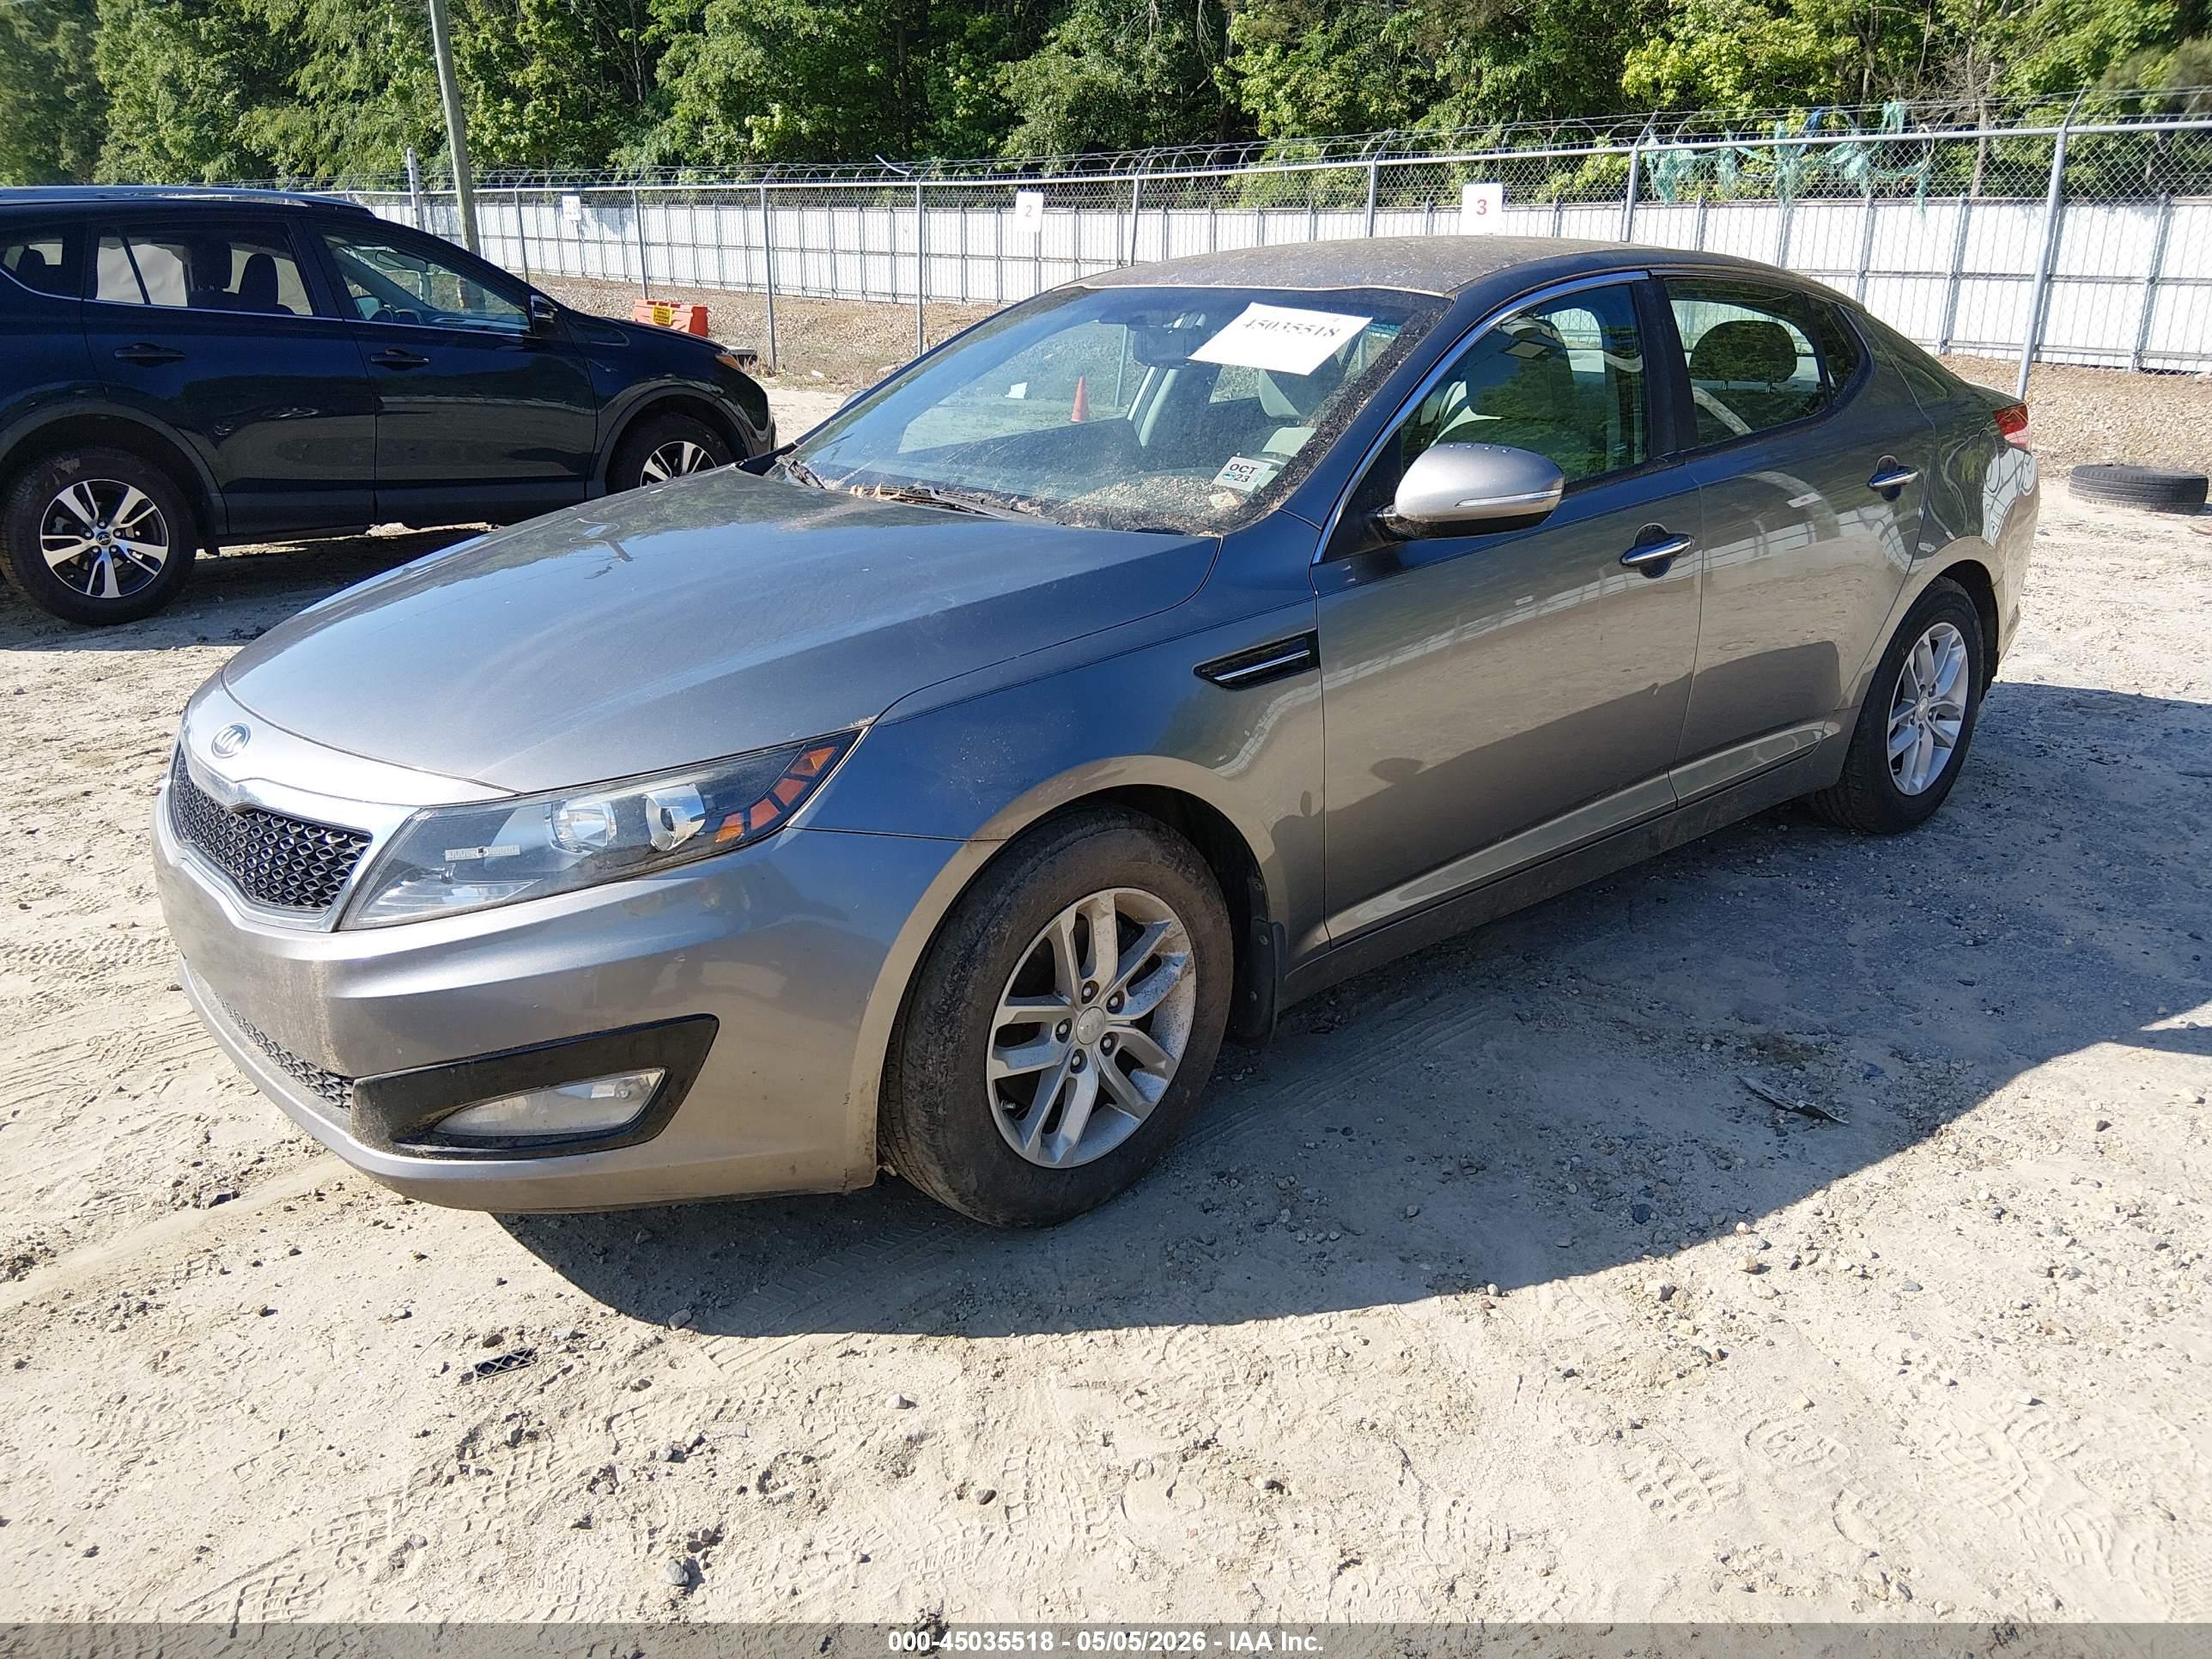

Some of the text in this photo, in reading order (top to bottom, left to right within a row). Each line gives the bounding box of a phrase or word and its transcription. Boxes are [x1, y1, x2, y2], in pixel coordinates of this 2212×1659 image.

[1024, 204, 1032, 217] 2
[1476, 198, 1487, 216] 3
[1243, 319, 1340, 337] 45035518
[1230, 464, 1259, 475] OCT
[1233, 474, 1250, 483] 23
